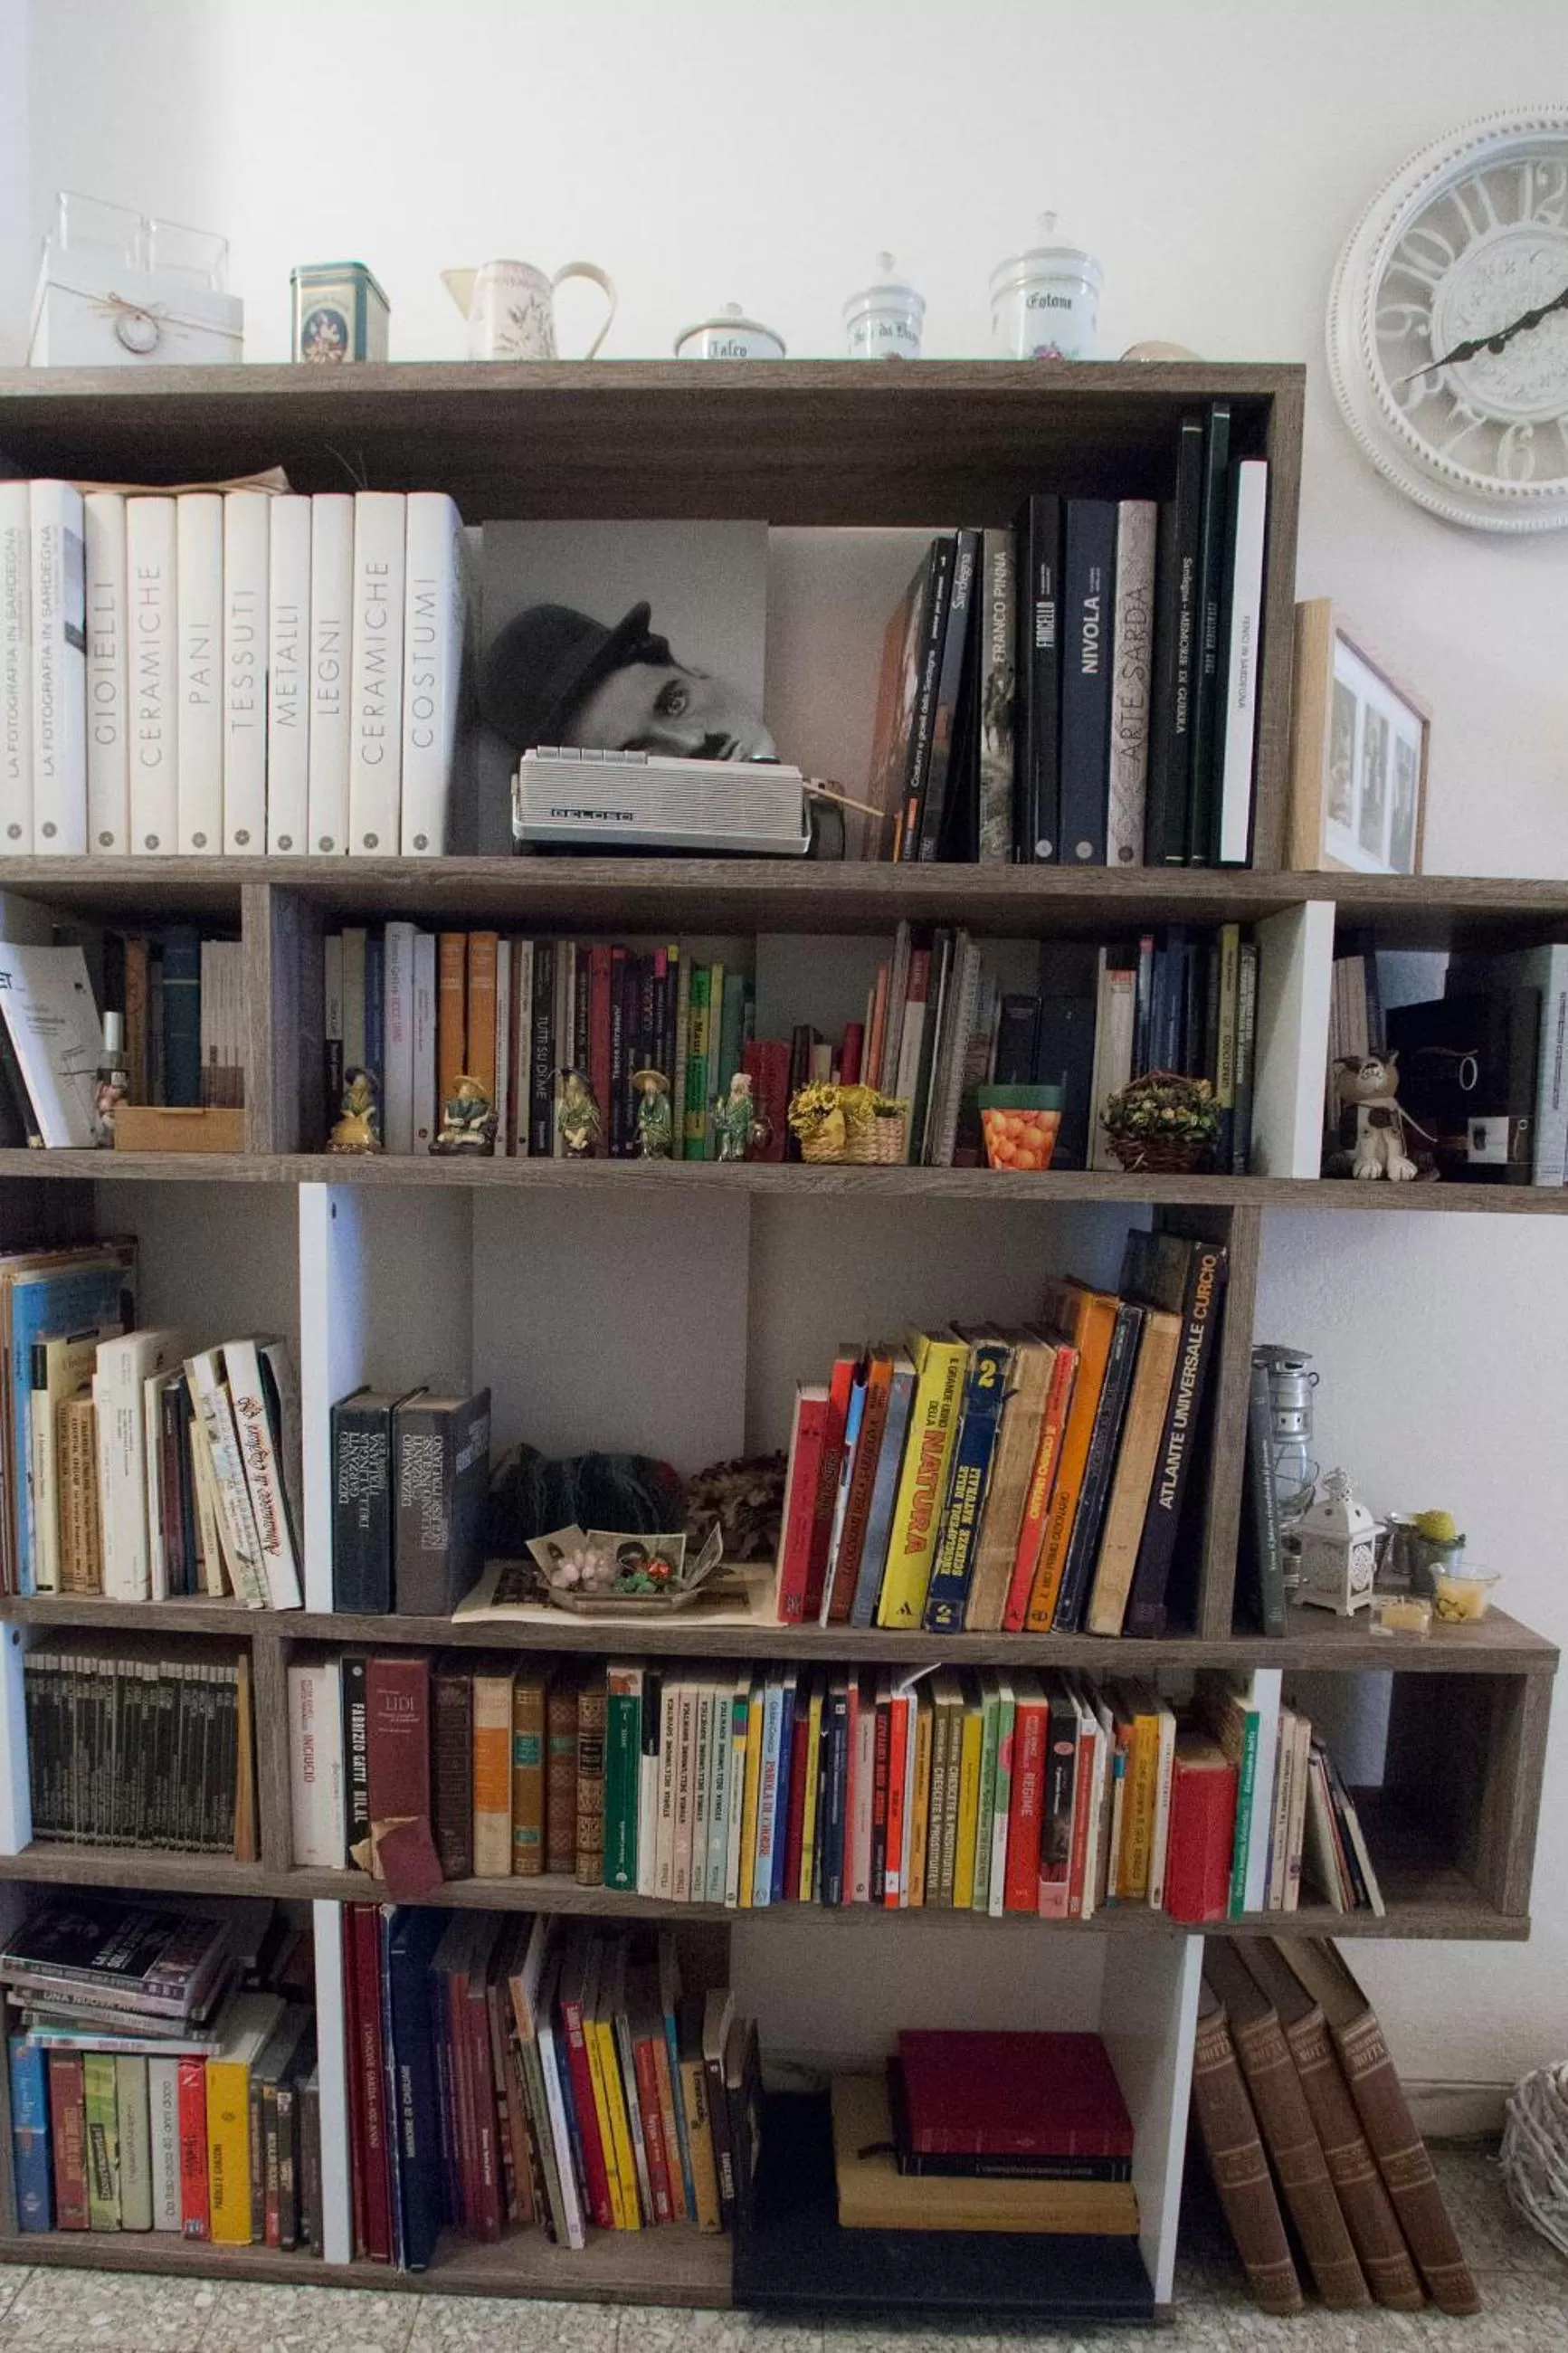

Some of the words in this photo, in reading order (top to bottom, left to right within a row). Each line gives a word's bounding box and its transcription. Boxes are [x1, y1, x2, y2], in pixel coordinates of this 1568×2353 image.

[1449, 170, 1499, 240] 11
[1383, 227, 1455, 288] 10
[1375, 303, 1430, 338] 9
[1440, 399, 1487, 454] 7
[1497, 424, 1535, 481] 6
[39, 525, 52, 618] SARDEGNA
[952, 553, 972, 609] Sardegna
[993, 552, 1008, 597] PINNA
[232, 591, 256, 734] TESSUTI
[993, 602, 1007, 662] FRANCO
[1081, 596, 1100, 674] NIVOLA
[1122, 586, 1147, 681] SARDA
[93, 584, 116, 745] GIOIELLI
[138, 566, 162, 767] CERAMICHE
[188, 624, 211, 704] PANI
[276, 605, 299, 728] METALLI
[318, 620, 339, 715] LEGNI
[361, 562, 388, 765] CERAMICHE
[412, 580, 437, 748] COSTUMI
[41, 646, 53, 750] FOTOGRAFIA
[1120, 697, 1142, 762] ARTE
[943, 1366, 957, 1402] GRANDE
[979, 1359, 995, 1388] 2
[1158, 1432, 1185, 1510] ATLANTE
[1174, 1324, 1204, 1428] UNIVERSALE
[1193, 1254, 1217, 1319] CURCIO
[926, 1400, 938, 1426] DELLA
[938, 1404, 951, 1428] LIBRO
[338, 1431, 349, 1504] DIZIONARIO
[349, 1432, 360, 1498] GARZANTI
[359, 1433, 369, 1481] LINGUA
[368, 1434, 379, 1495] ITALIANA
[402, 1434, 412, 1507] DIZIONARIO
[413, 1435, 423, 1500] GARZANTI
[432, 1435, 443, 1496] ITALIANO
[358, 1487, 369, 1528] DELLA
[905, 1430, 947, 1555] NATURA
[940, 1502, 961, 1576] ENCICLOPEDIA
[955, 1465, 968, 1499] DELLE
[953, 1529, 970, 1577] SCIENZE
[962, 1468, 981, 1525] NATURALI
[351, 1702, 366, 1751] FABRIZIO
[664, 1699, 674, 1737] SOVIETICA
[682, 1702, 690, 1742] SOVIETICA
[302, 1734, 315, 1783] INCIUCIO
[353, 1755, 366, 1782] GATTI
[946, 1766, 959, 1811] CRESCETE
[354, 1789, 367, 1824] BILAL
[663, 1791, 671, 1817] STORIA
[933, 1767, 945, 1813] CRESCETE
[927, 1824, 940, 1888] PROSTITUITEVI
